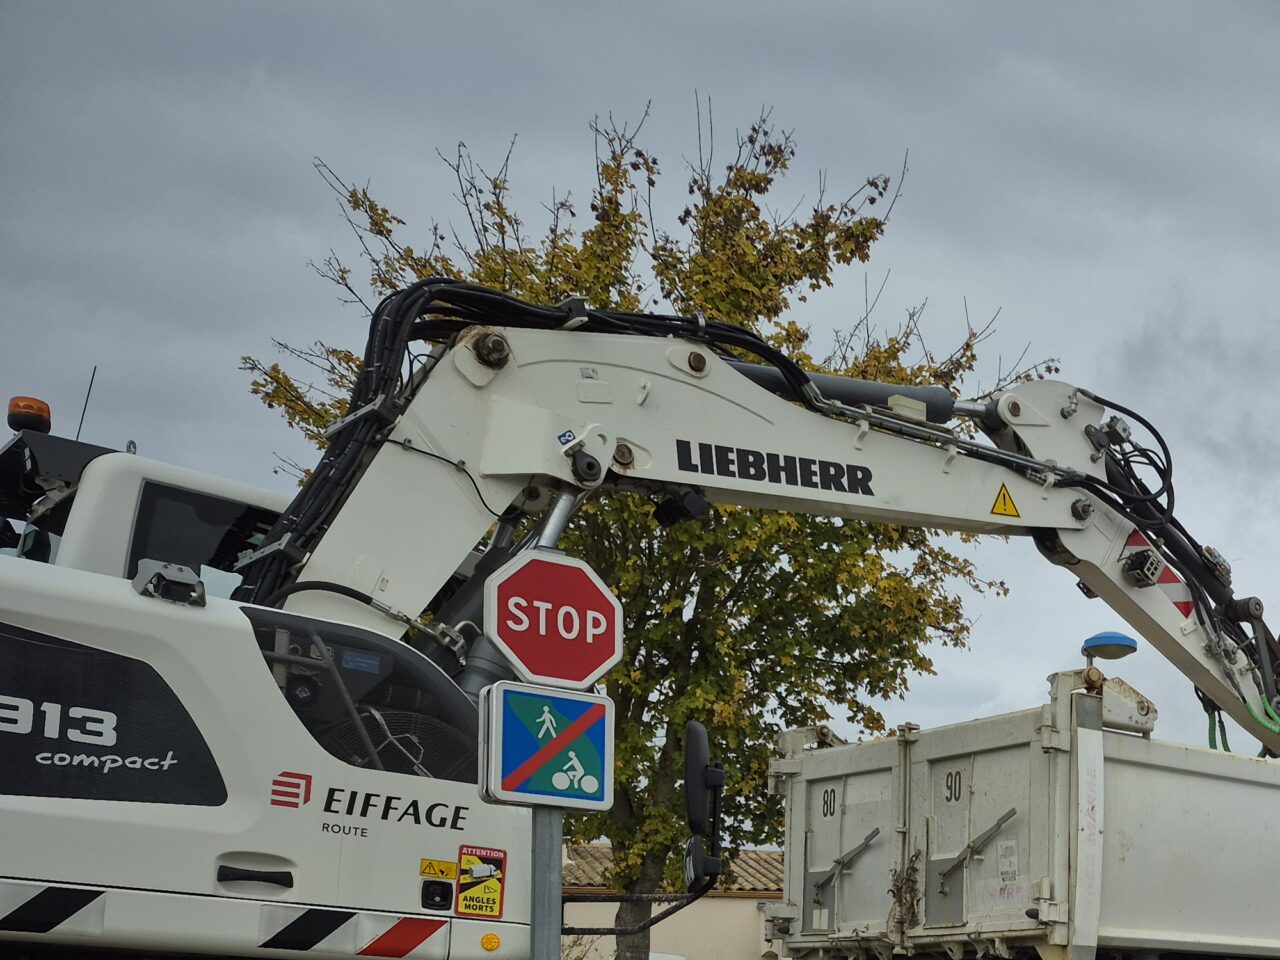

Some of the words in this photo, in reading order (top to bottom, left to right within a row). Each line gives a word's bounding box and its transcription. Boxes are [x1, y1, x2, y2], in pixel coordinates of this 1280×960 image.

[676, 439, 875, 496] LIEBHERR
[506, 596, 608, 644] STOP
[0, 694, 118, 747] 913
[35, 750, 178, 774] compact
[945, 770, 962, 803] 90
[323, 787, 470, 831] EIFFAGE
[822, 788, 836, 818] 80
[322, 822, 368, 838] ROUTE
[462, 847, 504, 859] ATTENTION
[463, 895, 497, 905] ANGLES
[464, 903, 495, 912] MORTS
